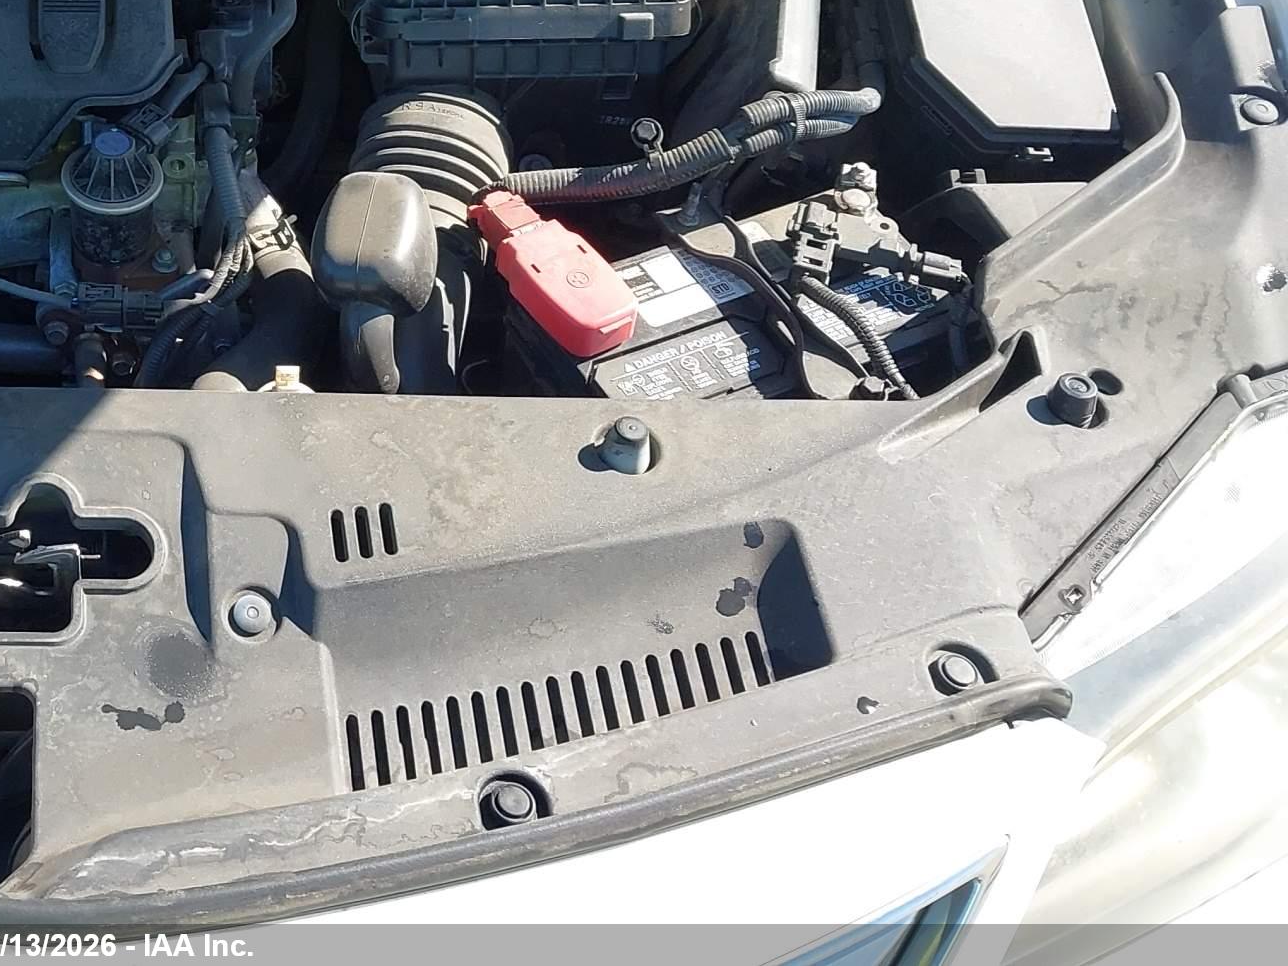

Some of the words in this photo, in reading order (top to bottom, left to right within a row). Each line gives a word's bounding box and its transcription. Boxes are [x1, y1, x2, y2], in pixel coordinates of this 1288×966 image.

[712, 282, 730, 294] STD
[633, 346, 680, 369] DANGER
[687, 330, 727, 352] POISON
